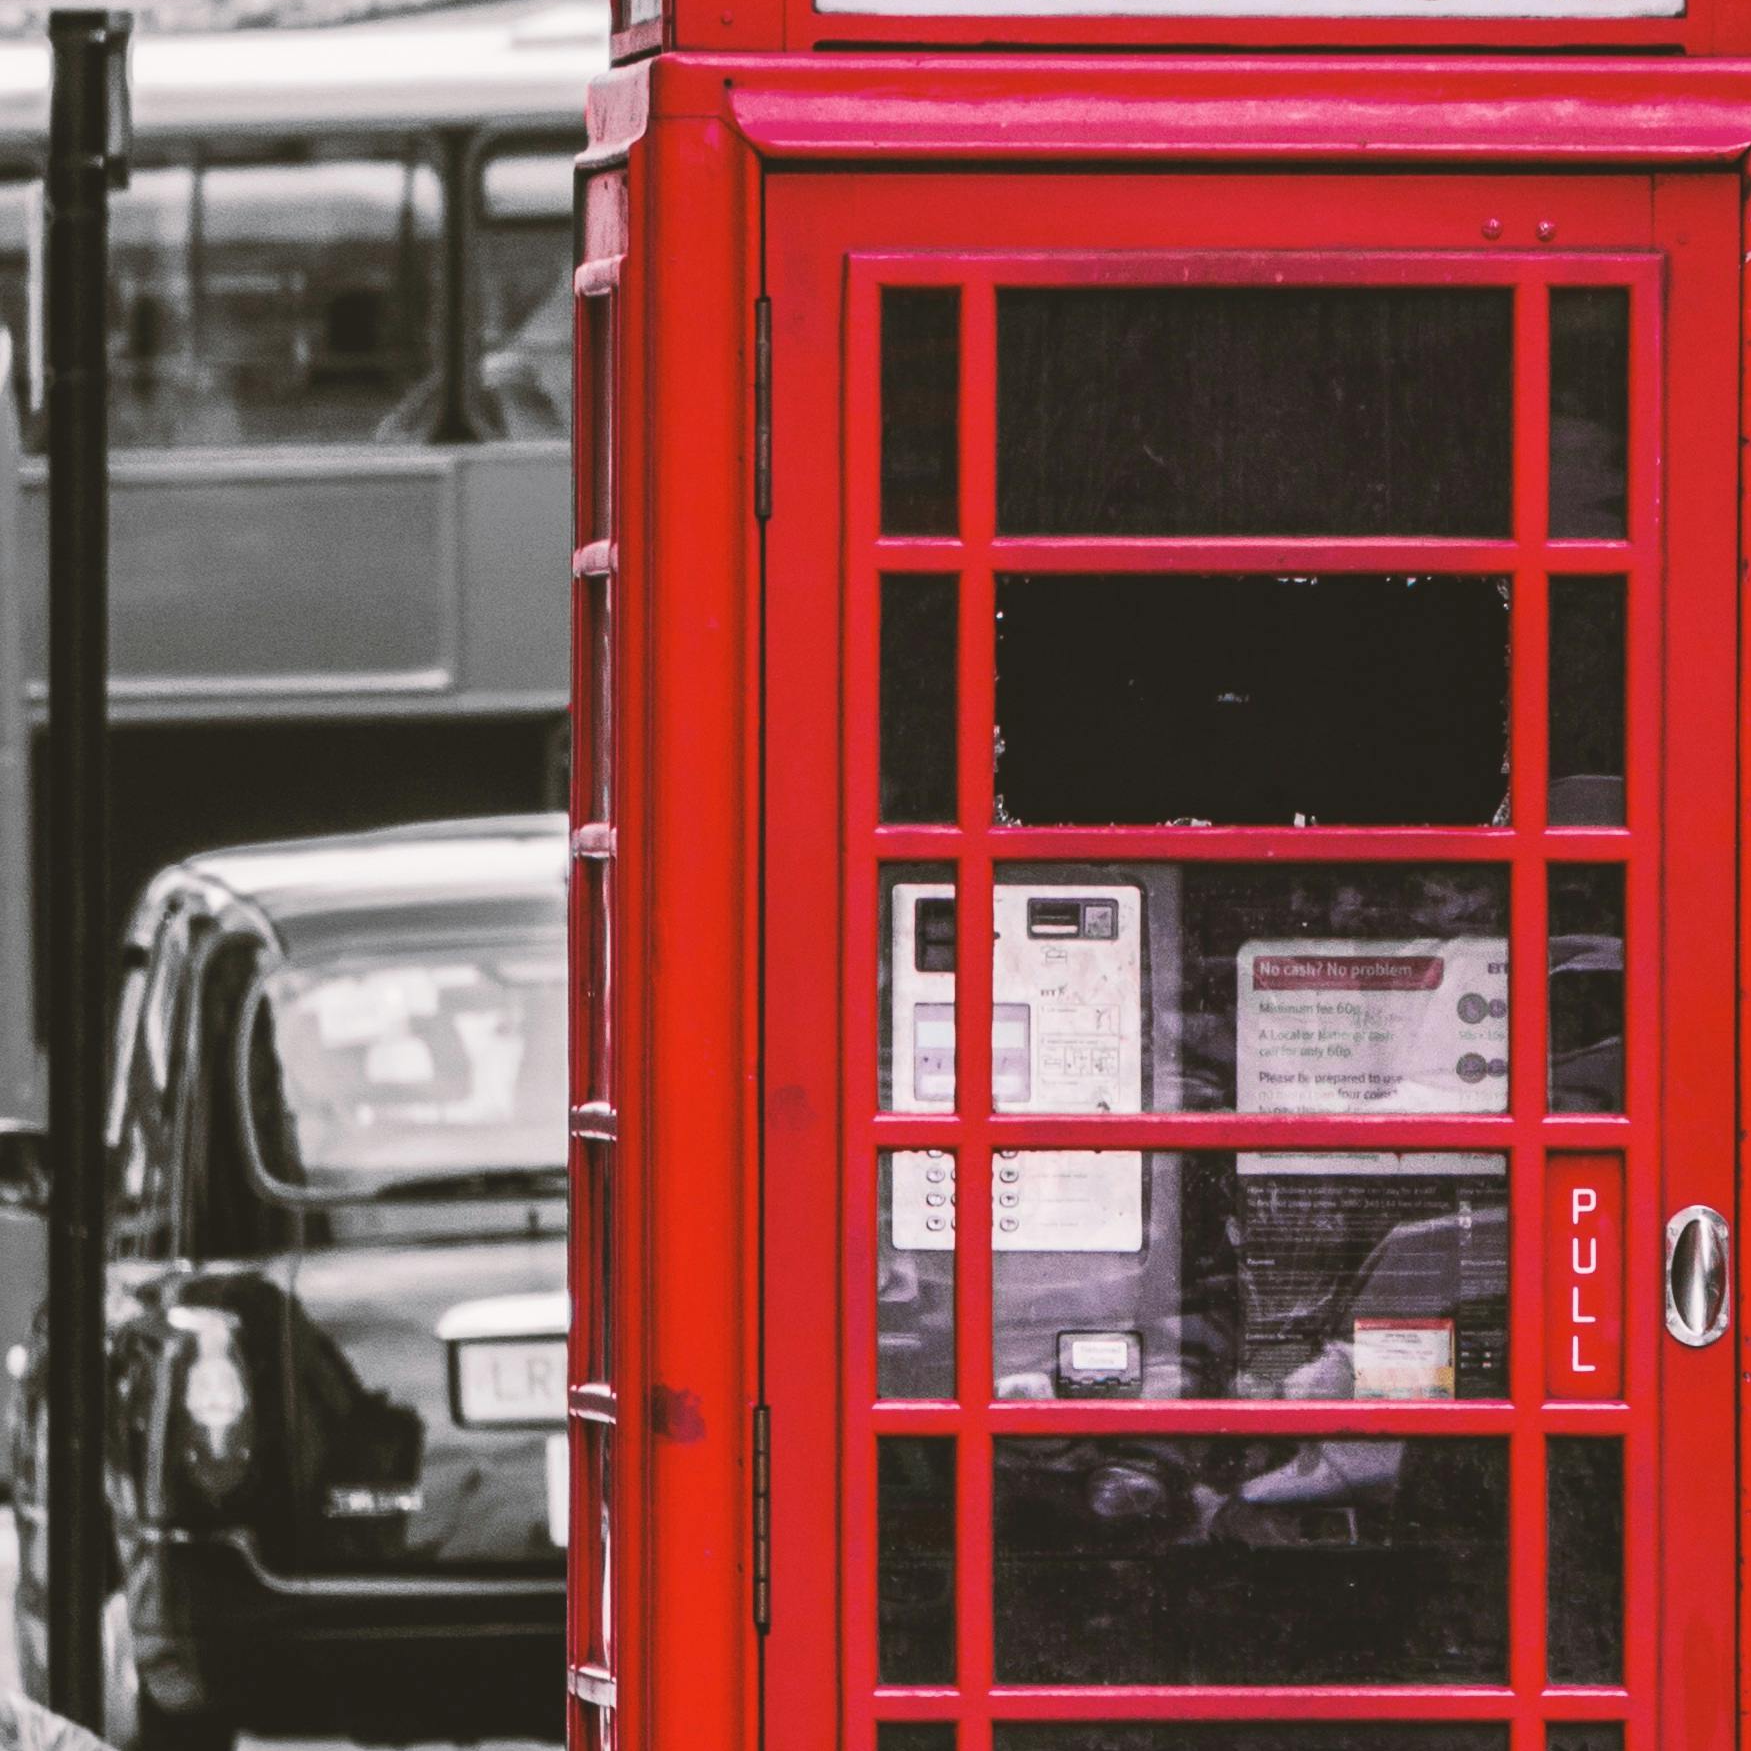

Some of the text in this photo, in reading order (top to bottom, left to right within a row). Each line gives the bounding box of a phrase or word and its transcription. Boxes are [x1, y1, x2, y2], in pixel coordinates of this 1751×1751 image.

[1260, 962, 1413, 979] No cash? No problem
[1259, 1003, 1314, 1013] Minimum
[1316, 1003, 1334, 1014] fee
[1259, 1072, 1295, 1083] Please
[1314, 1073, 1366, 1086] prepared
[1368, 1073, 1381, 1083] to
[1572, 1188, 1597, 1372] PULL
